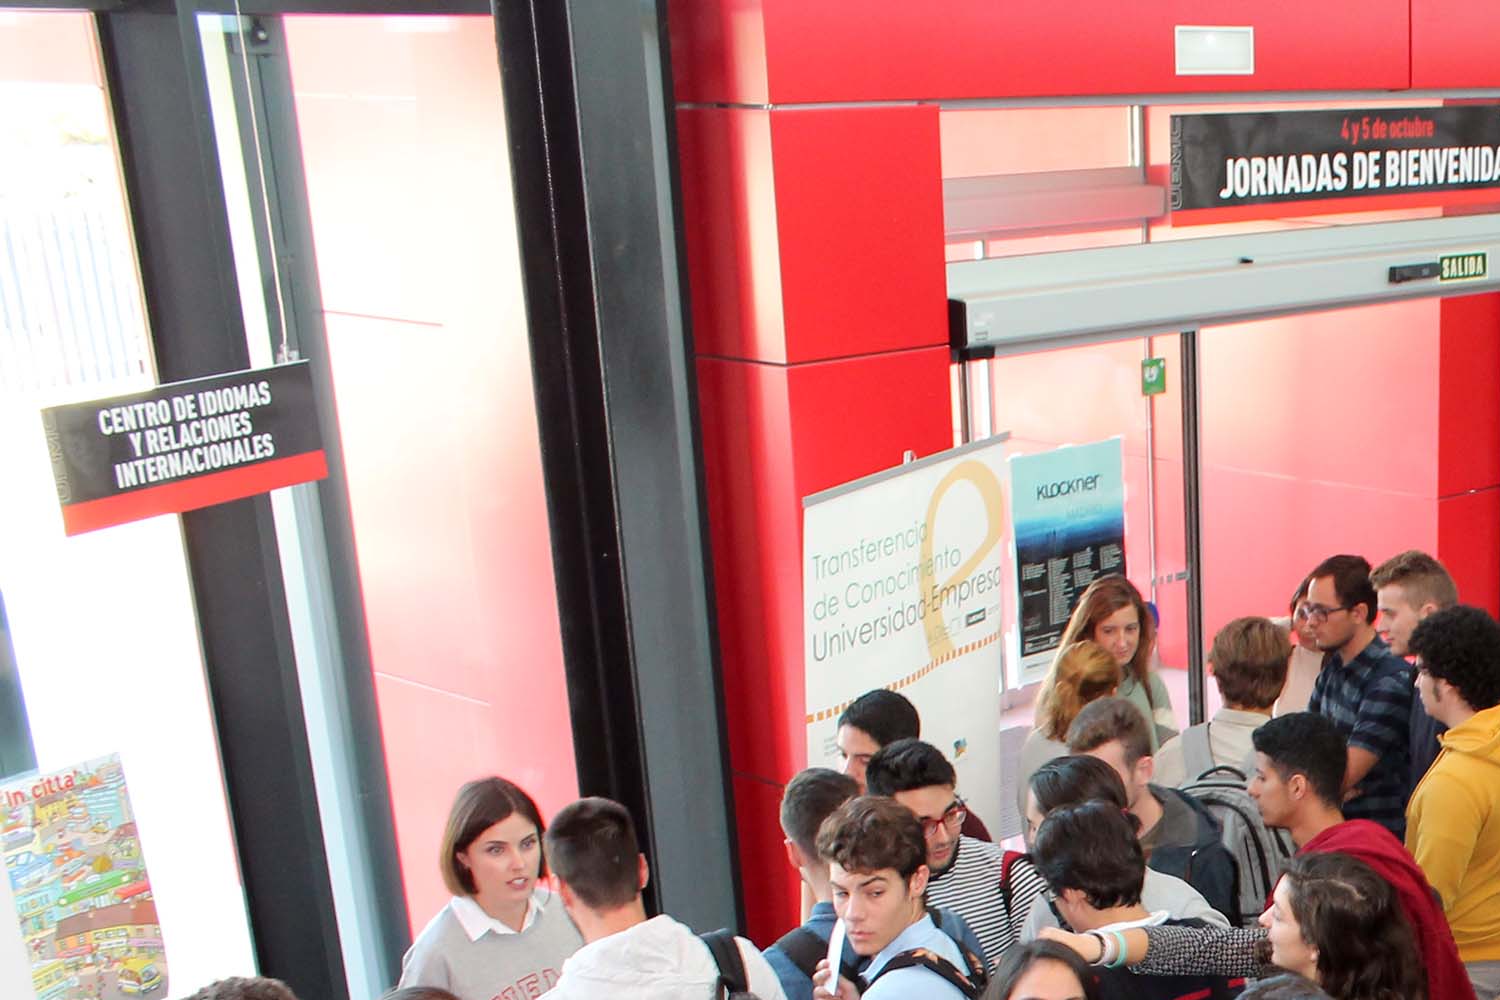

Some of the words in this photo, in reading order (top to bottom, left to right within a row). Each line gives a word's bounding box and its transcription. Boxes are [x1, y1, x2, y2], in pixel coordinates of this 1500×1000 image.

[1341, 117, 1349, 140] 4
[1351, 122, 1360, 145] y
[1362, 116, 1370, 139] 5
[1372, 116, 1387, 139] de
[1389, 115, 1435, 139] octubre
[1219, 151, 1349, 199] JORNADAS
[1353, 150, 1381, 190] DE
[1442, 255, 1484, 279] SALIDA
[98, 398, 171, 435] CENTRO
[172, 394, 198, 422] DE
[198, 381, 272, 418] IDIOMAS
[128, 432, 143, 457] Y
[145, 411, 253, 454] RELACIONES
[114, 433, 275, 489] INTERNACIONALES
[812, 520, 928, 581] Transferencia
[813, 592, 839, 621] de
